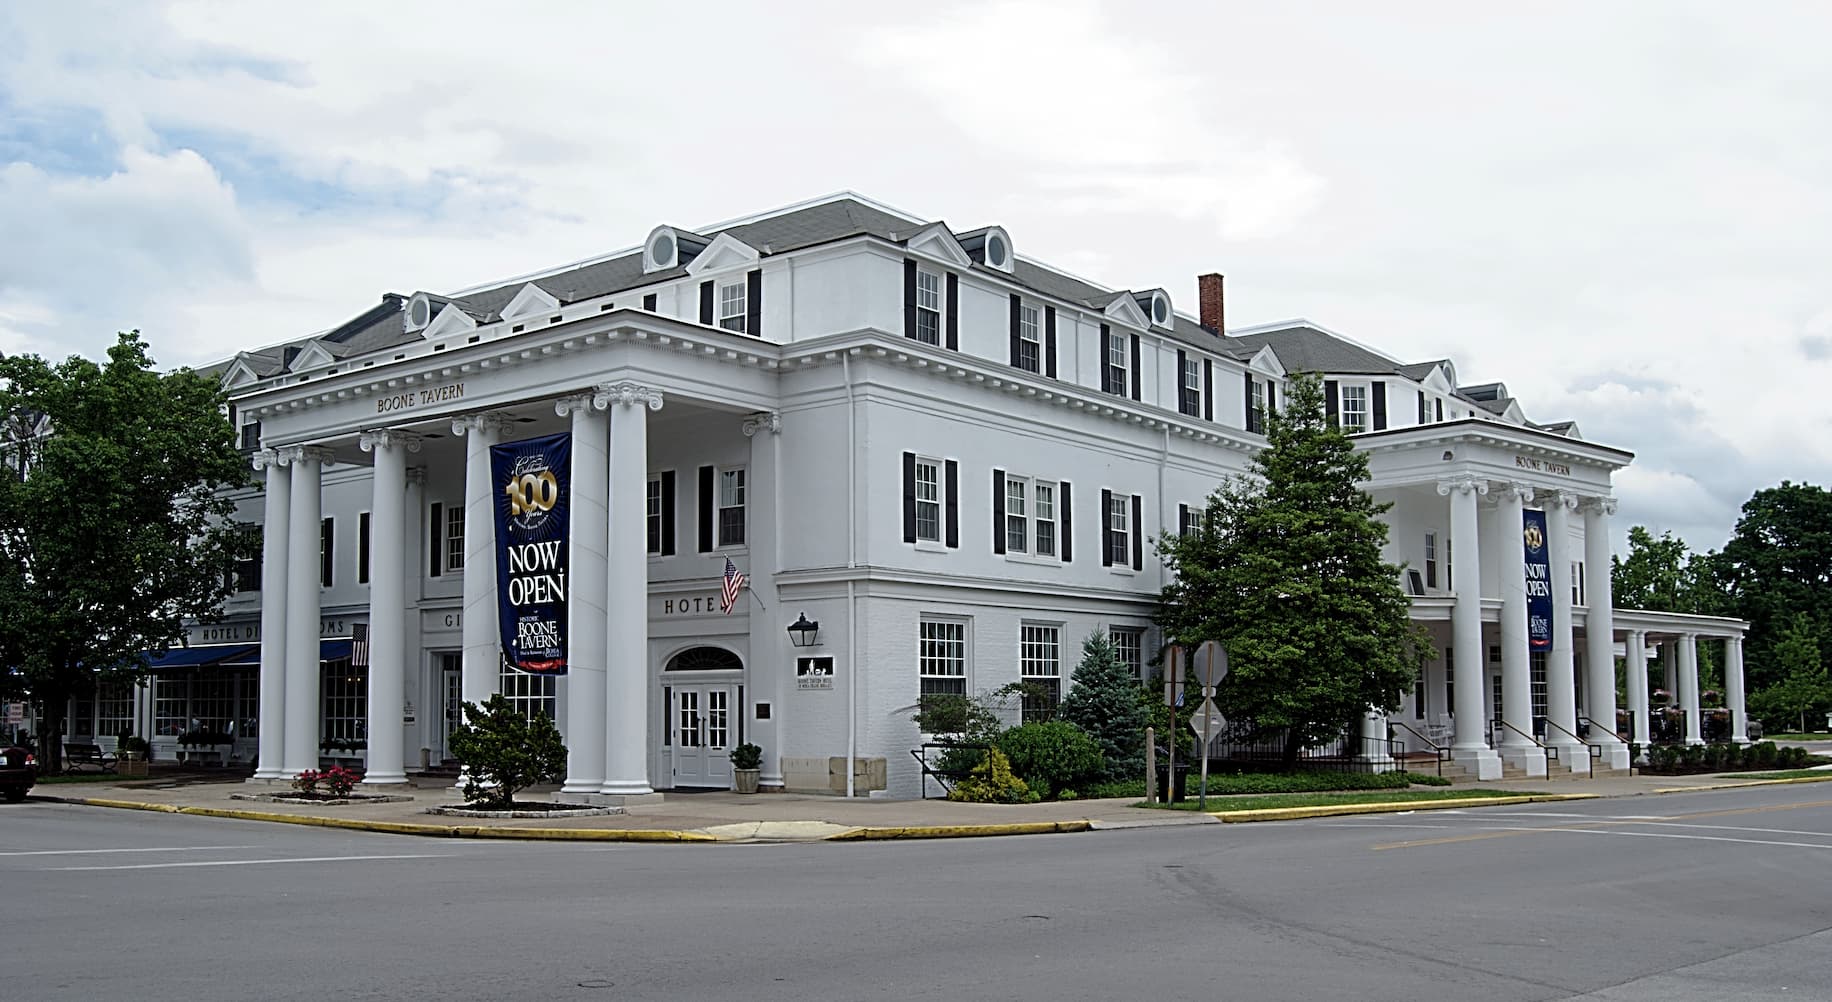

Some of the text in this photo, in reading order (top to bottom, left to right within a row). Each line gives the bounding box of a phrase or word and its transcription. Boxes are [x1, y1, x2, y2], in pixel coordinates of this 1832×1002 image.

[378, 383, 464, 413] BOONE TAVERN
[1515, 456, 1570, 476] BOONE TAVERN
[506, 471, 558, 515] 100
[508, 541, 561, 573] NOW
[1525, 563, 1546, 579] NOW
[509, 573, 565, 606] OPEN
[1526, 580, 1549, 597] OPEN
[665, 597, 728, 614] HOTE
[445, 614, 460, 627] GI
[518, 621, 557, 636] BOONE
[203, 620, 344, 640] HOTEL DI OMS
[518, 634, 558, 649] TAVERN
